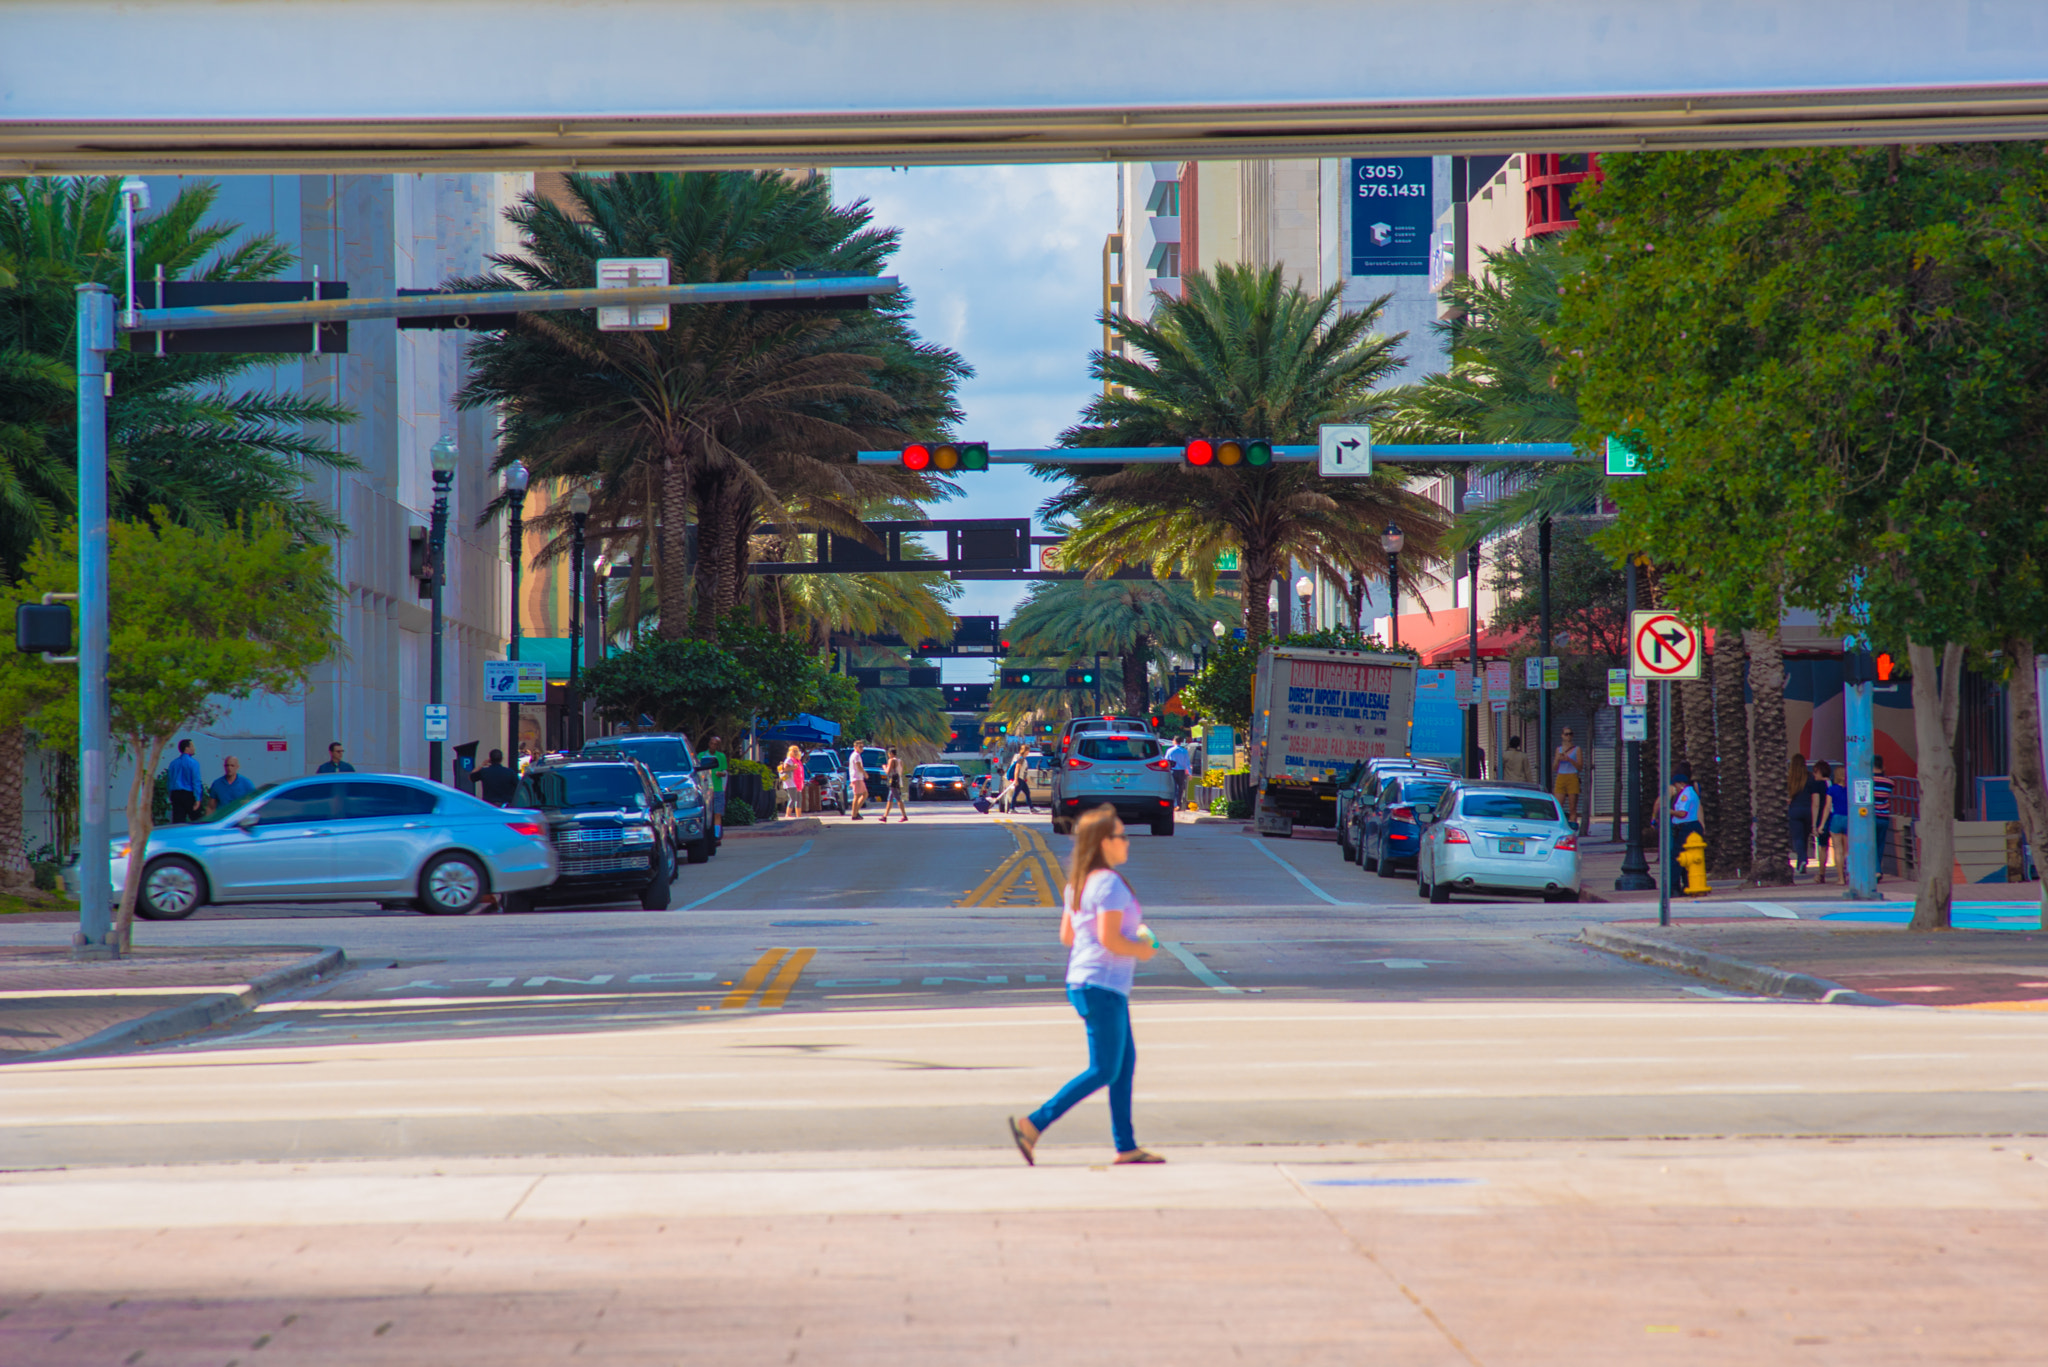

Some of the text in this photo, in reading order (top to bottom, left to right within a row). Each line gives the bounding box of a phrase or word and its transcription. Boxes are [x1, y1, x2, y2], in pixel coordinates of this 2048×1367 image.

[1359, 165, 1403, 180] (305)
[1359, 184, 1425, 197] 576.1431
[1293, 662, 1391, 693] RAMA LUGGAGE & BAGS
[1288, 686, 1390, 710] DIRECT IMPORT & WHOLESALE
[1322, 706, 1343, 718] STREET
[1413, 742, 1440, 751] OPEN
[463, 758, 471, 769] P
